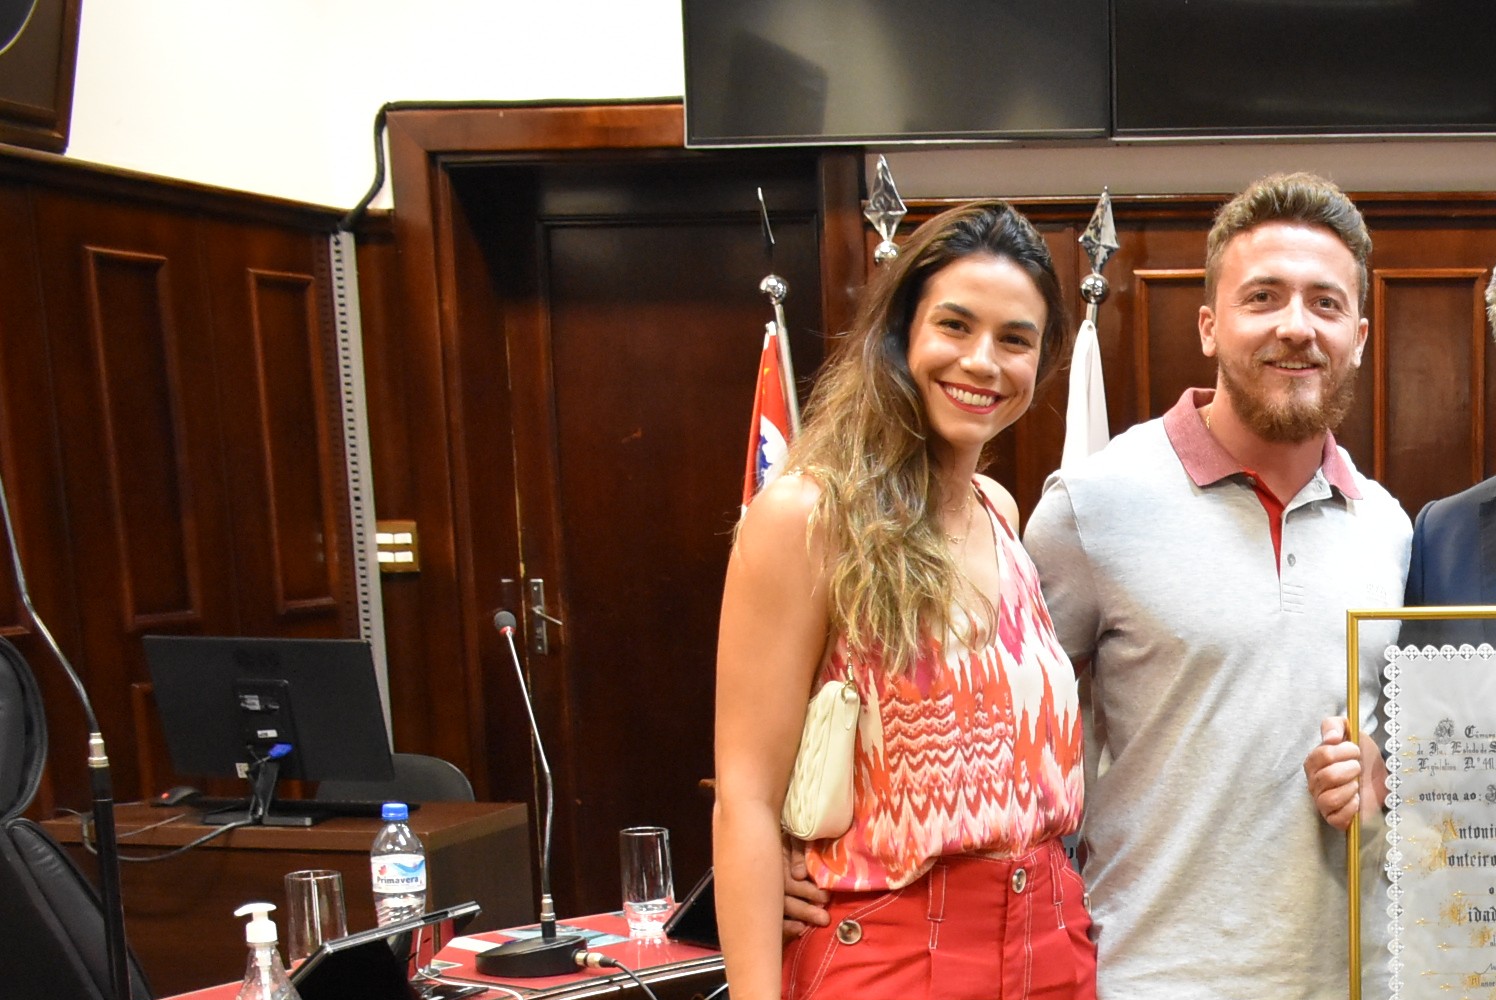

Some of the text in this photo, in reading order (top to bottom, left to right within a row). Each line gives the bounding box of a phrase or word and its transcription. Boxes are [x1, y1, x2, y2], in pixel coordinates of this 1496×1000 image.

[1419, 790, 1459, 804] outorga
[376, 876, 419, 884] Primavera
[1488, 886, 1495, 895] o
